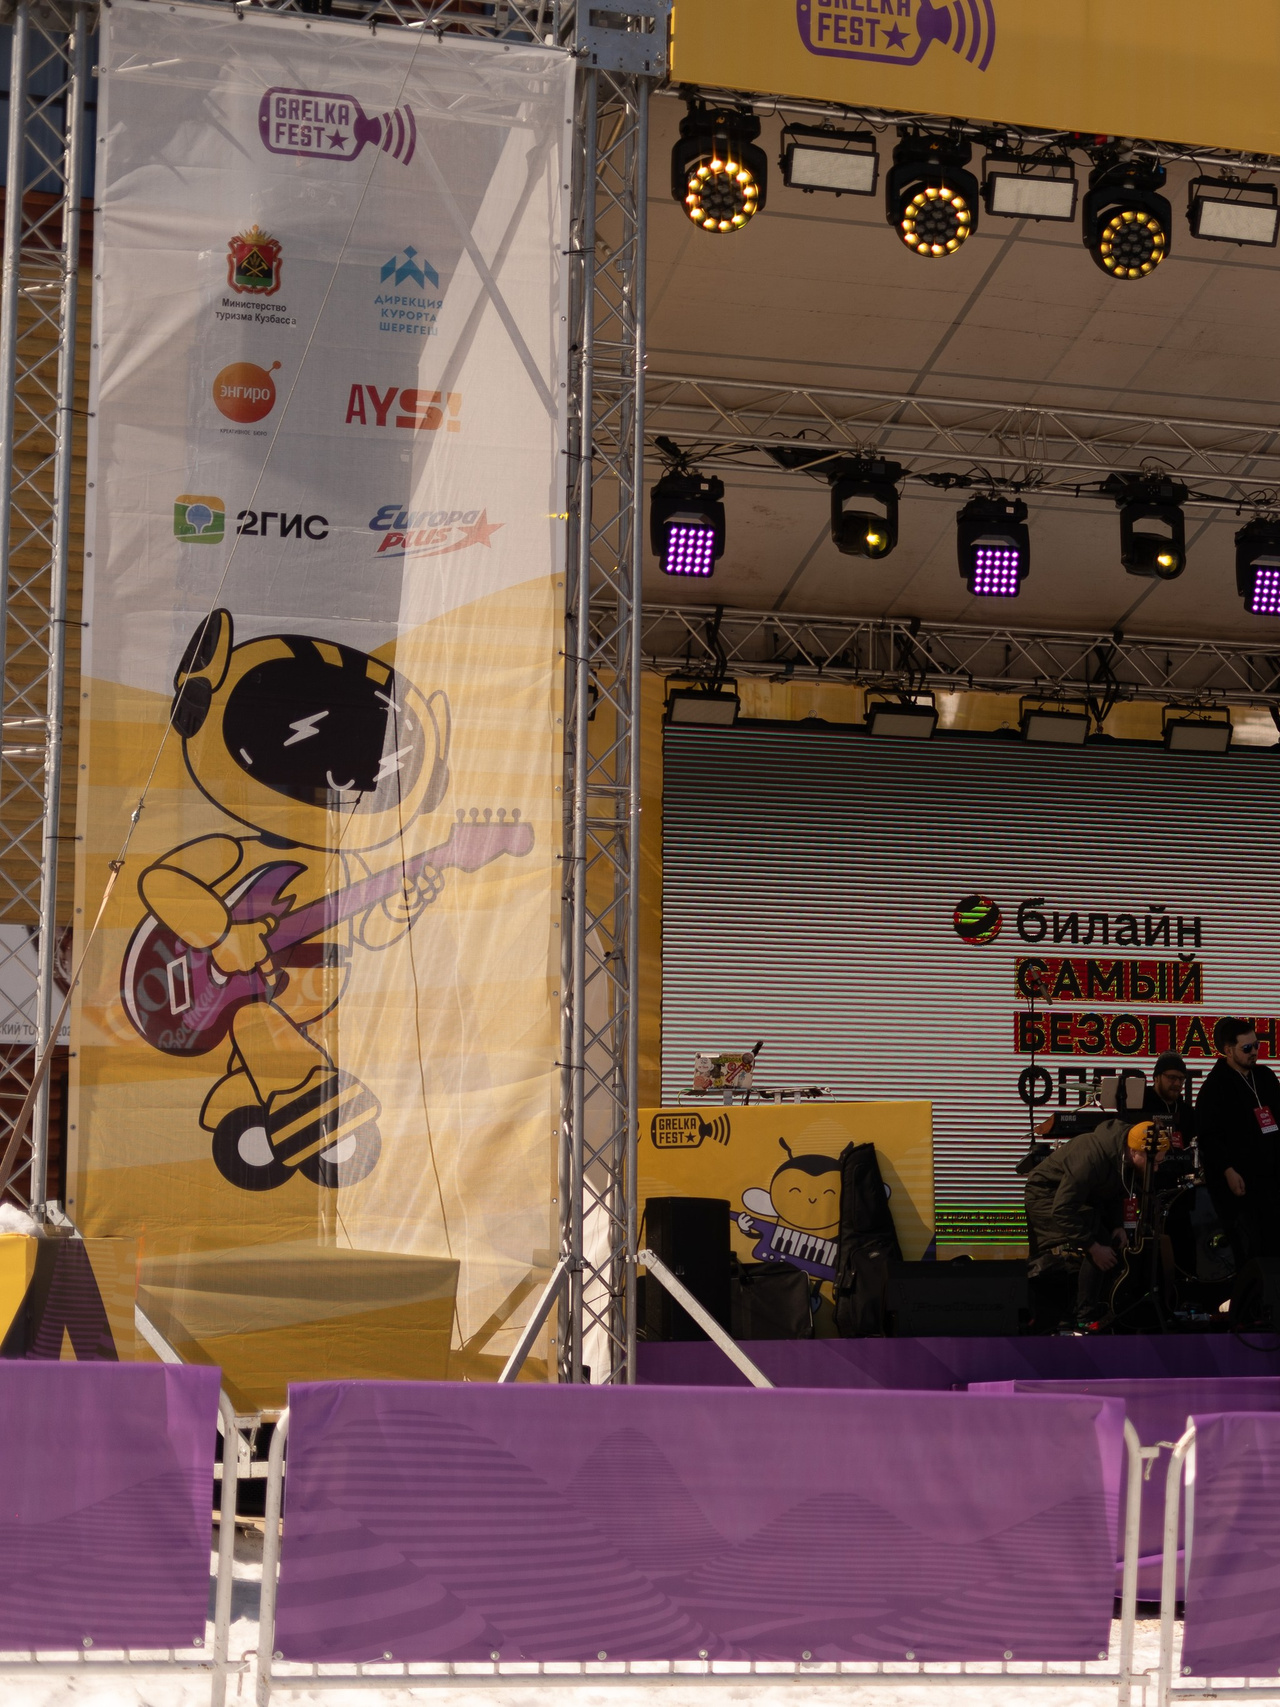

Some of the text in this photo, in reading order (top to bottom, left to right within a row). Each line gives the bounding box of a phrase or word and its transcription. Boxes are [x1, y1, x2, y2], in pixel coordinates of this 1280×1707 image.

[818, 12, 880, 47] FEST
[275, 97, 349, 126] GRELKA
[275, 122, 325, 148] FEST
[222, 298, 287, 312] Министерство
[374, 295, 443, 309] ДИРЕКЦИЯ
[215, 311, 297, 325] туризма Кузбасса
[381, 308, 437, 323] КУРОРТА
[379, 322, 438, 336] ШЕРЕГЕШ
[220, 385, 270, 403] энгиро
[345, 383, 462, 433] AYS!
[236, 509, 329, 541] 2ГИС
[1016, 897, 1202, 948] билайн
[1016, 953, 1202, 1001] САМЫЙ
[658, 1117, 697, 1130] GRELKA
[659, 1131, 685, 1144] FEST
